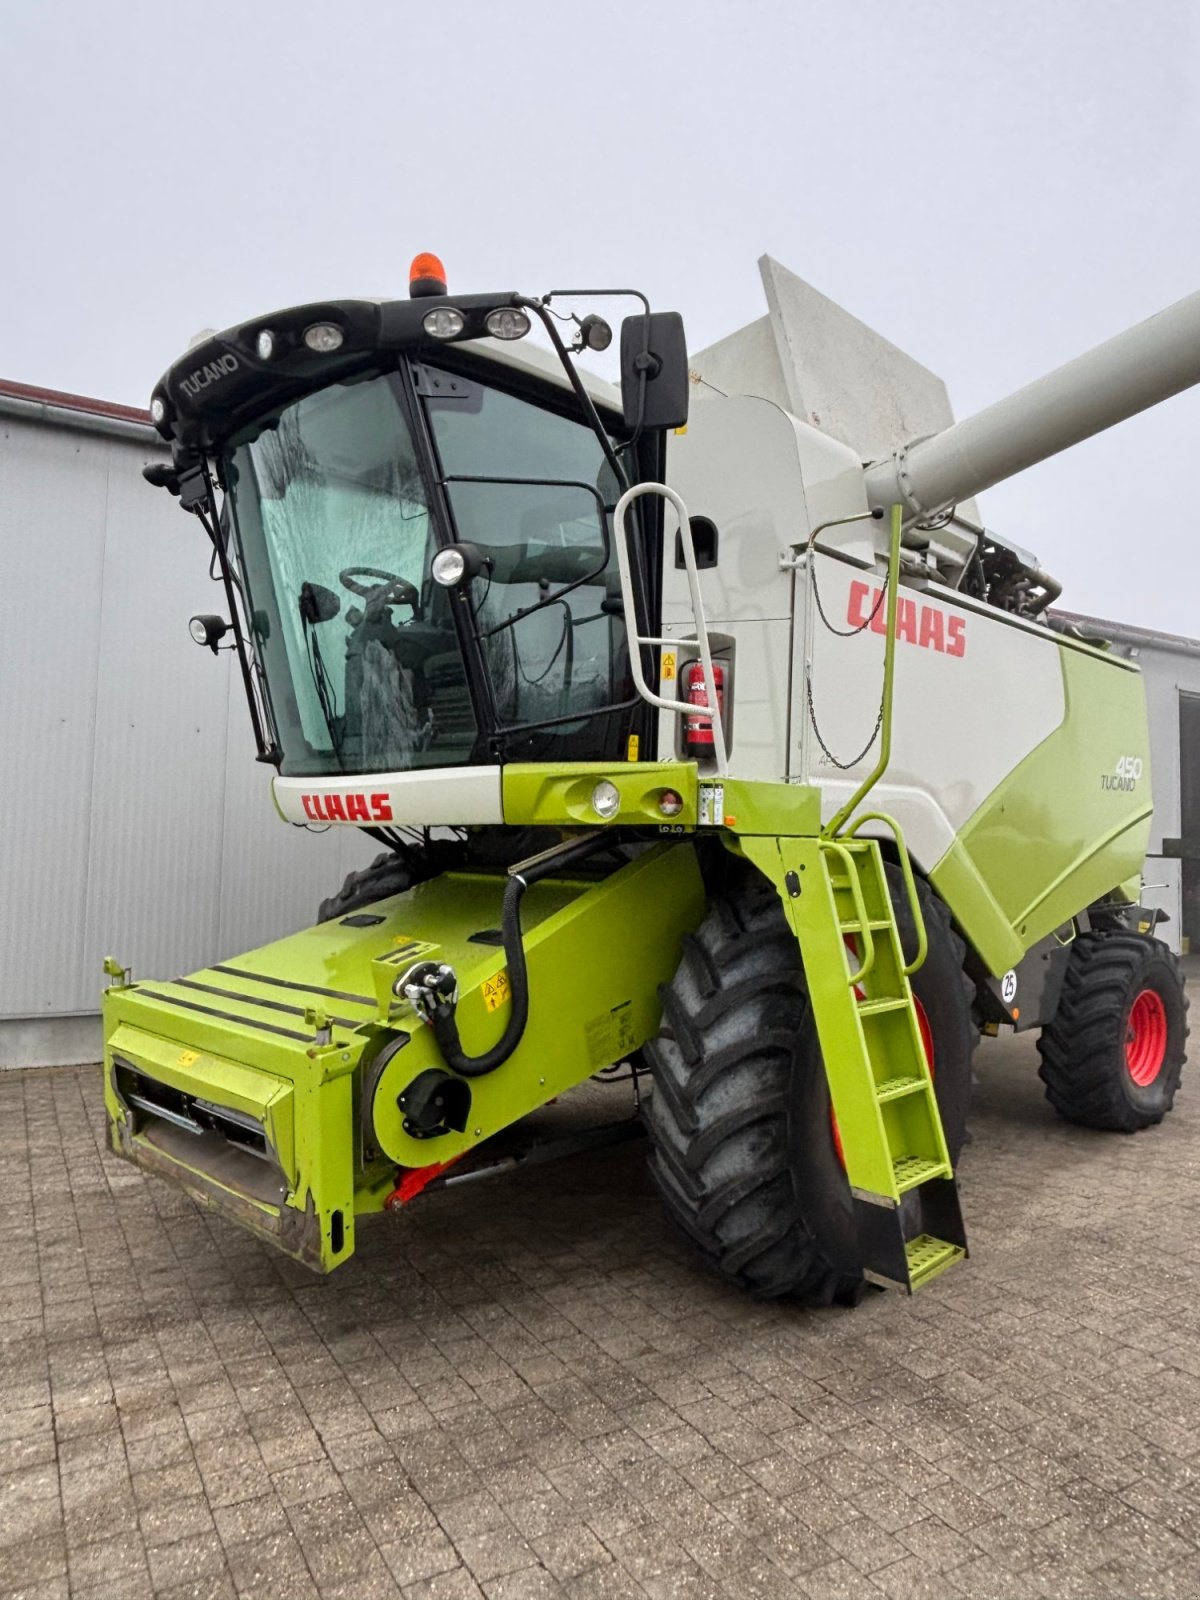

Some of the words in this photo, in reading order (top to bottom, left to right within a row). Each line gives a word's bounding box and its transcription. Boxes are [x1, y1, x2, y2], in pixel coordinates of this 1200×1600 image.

[180, 354, 239, 397] TUCANO
[847, 580, 966, 657] CLAAS
[1116, 755, 1143, 779] 450
[1102, 774, 1136, 792] TUCANO
[301, 794, 393, 821] CLAAS
